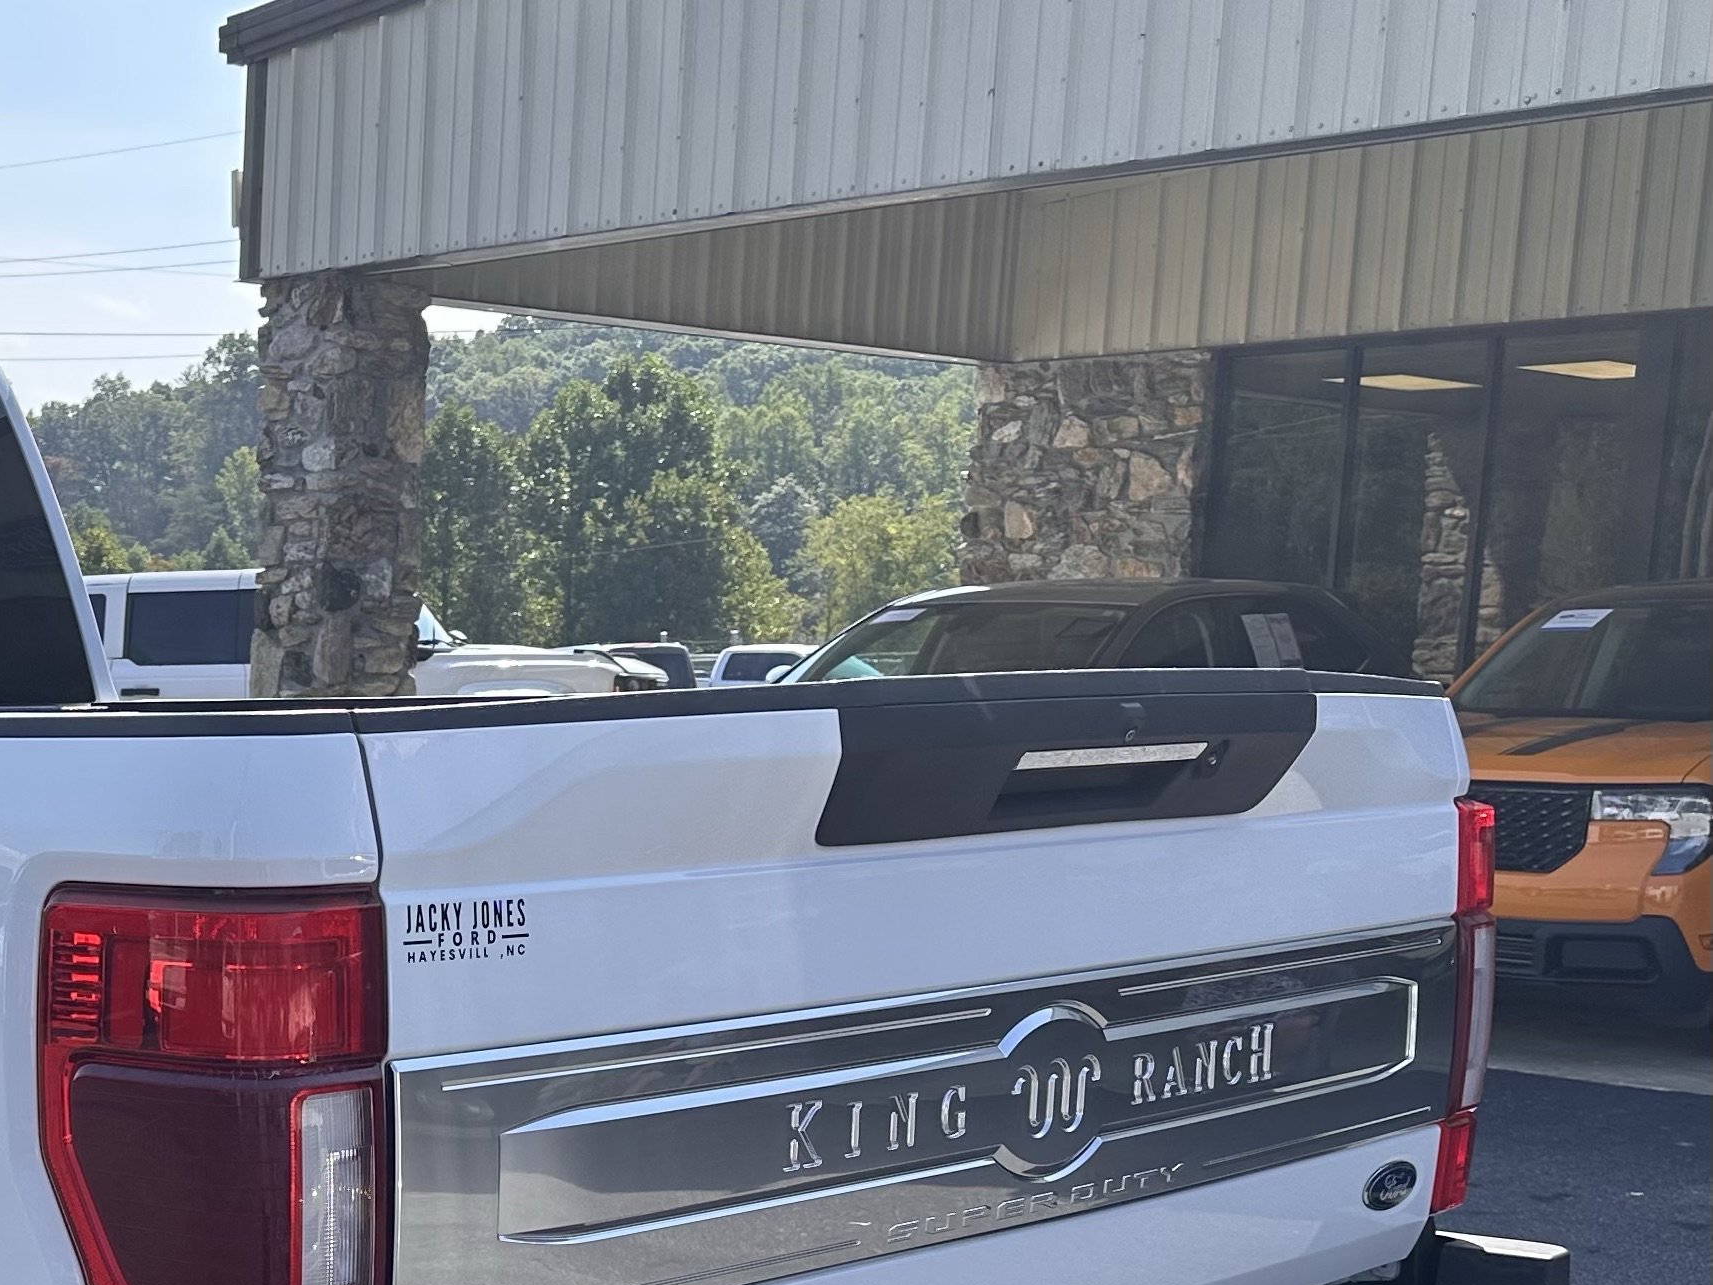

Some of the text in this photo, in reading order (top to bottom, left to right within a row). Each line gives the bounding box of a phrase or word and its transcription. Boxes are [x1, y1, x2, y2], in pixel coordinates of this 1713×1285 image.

[406, 898, 526, 934] JACKY JONES
[407, 947, 489, 963] HAYESVILL
[437, 930, 497, 948] FORD
[782, 1022, 1276, 1173] KING RANCH
[886, 1162, 1185, 1244] SUPER DUTY
